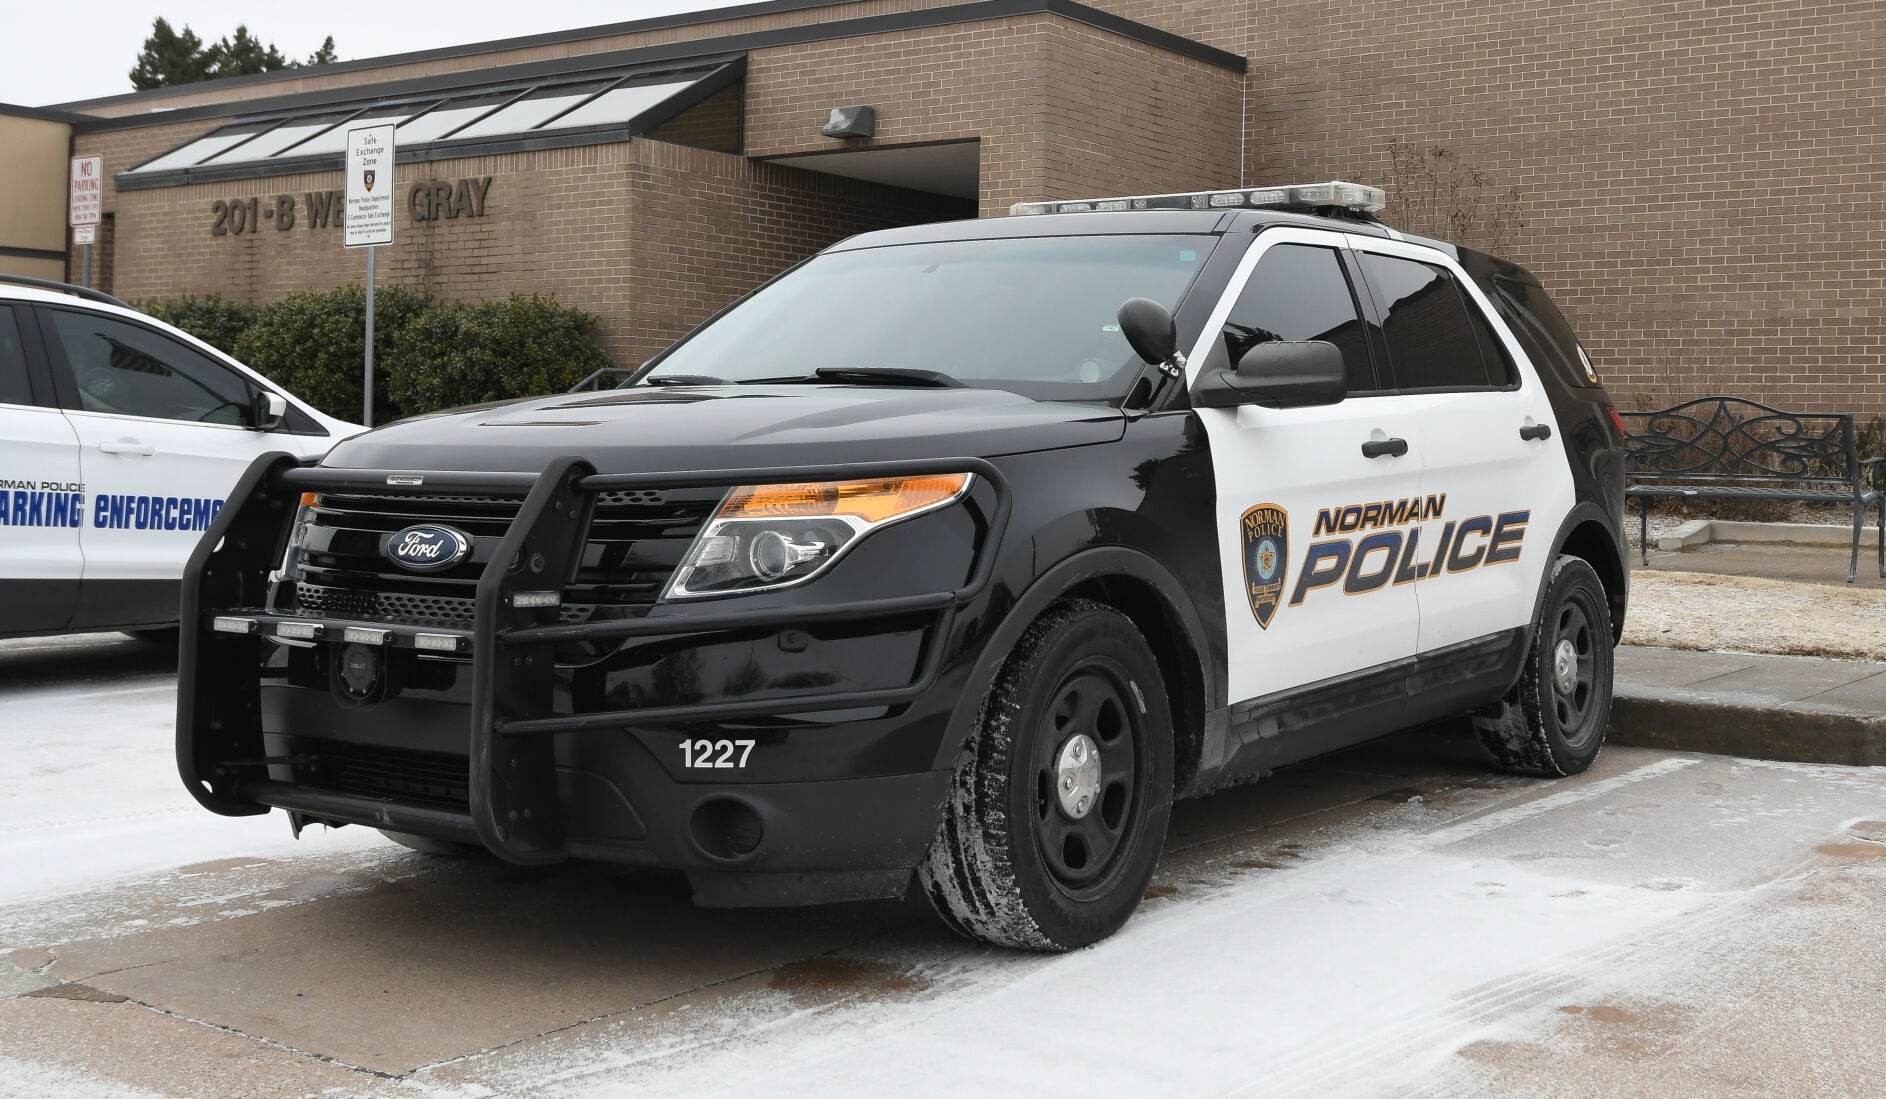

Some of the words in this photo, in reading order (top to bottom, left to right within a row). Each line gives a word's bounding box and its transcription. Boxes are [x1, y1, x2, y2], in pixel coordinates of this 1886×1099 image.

[364, 136, 377, 145] Safe
[356, 147, 384, 156] Exchange
[362, 157, 377, 166] Zone
[81, 161, 93, 177] NO
[74, 178, 99, 192] PARKING
[305, 190, 345, 229] WE
[408, 177, 492, 221] GRAY
[41, 482, 86, 493] POLICE
[0, 490, 85, 528] ARKING
[1312, 493, 1447, 538] NORMAN
[1246, 509, 1285, 530] NORMAN
[1247, 523, 1283, 543] POLICE
[398, 531, 444, 558] Ford
[1288, 510, 1531, 607] POLICE
[679, 739, 756, 768] 1227
